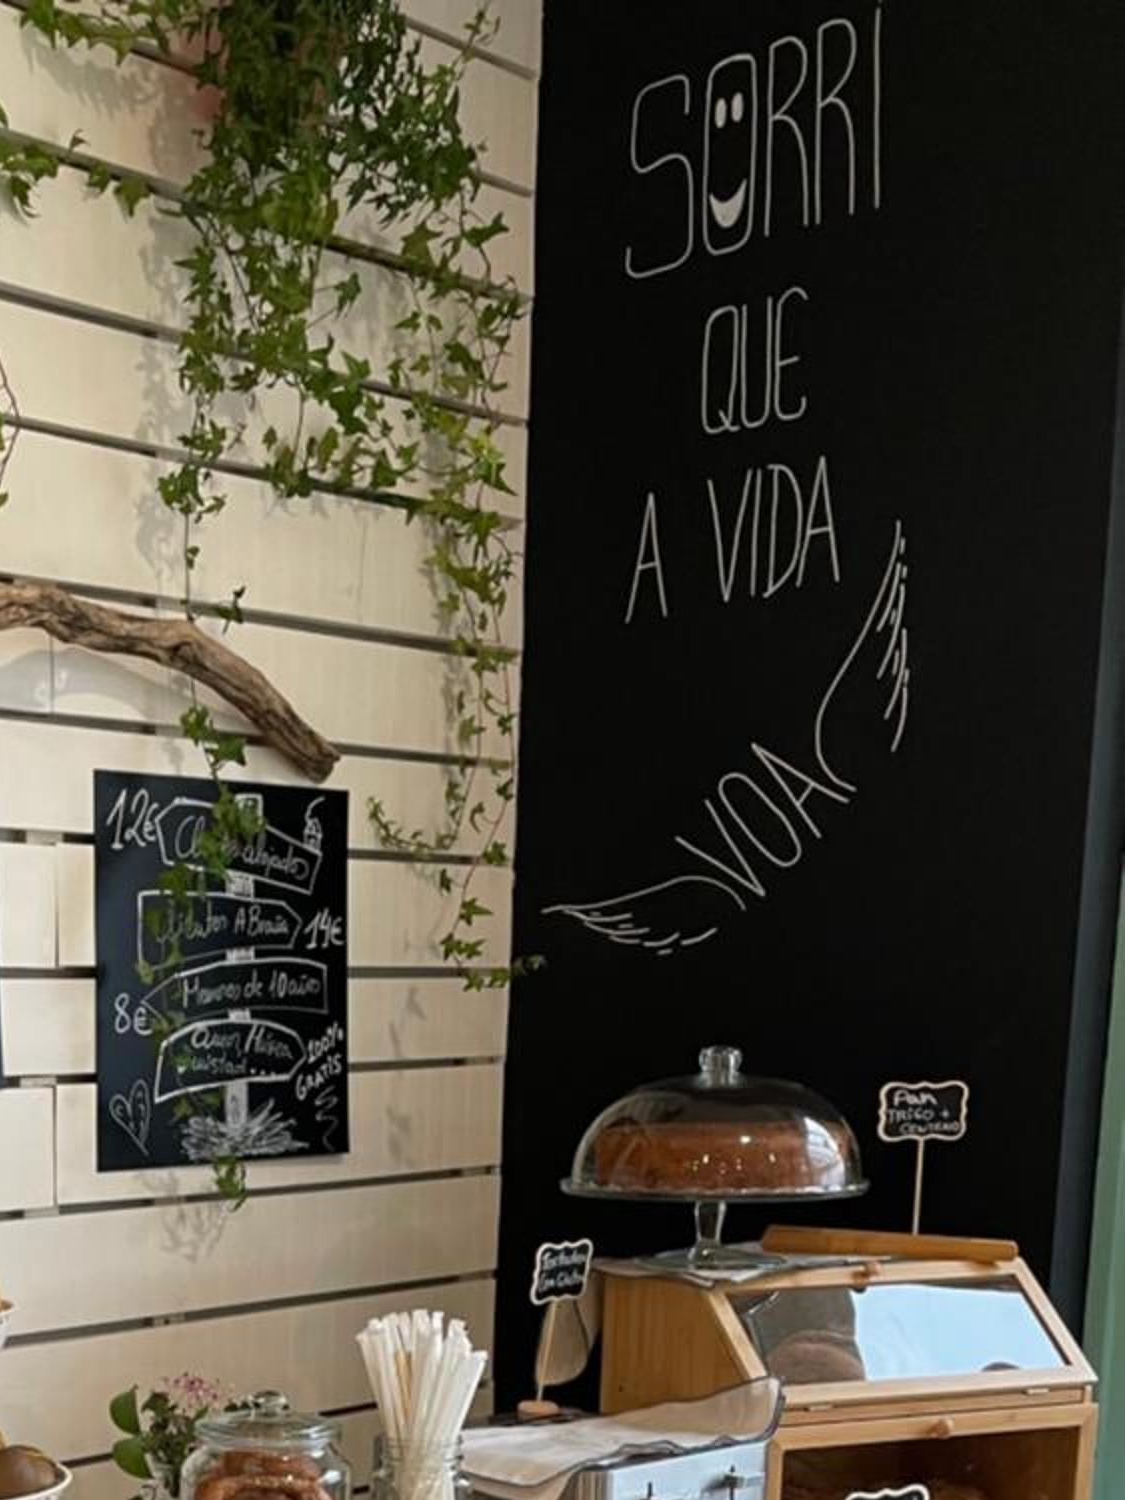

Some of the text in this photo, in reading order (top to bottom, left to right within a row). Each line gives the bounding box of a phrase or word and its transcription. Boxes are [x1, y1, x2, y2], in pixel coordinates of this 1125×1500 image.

[625, 9, 881, 279] SORRI
[701, 287, 809, 434] QUE
[625, 455, 840, 624] A VIDA
[676, 741, 852, 896] VOA
[304, 908, 346, 949] 14€
[114, 993, 153, 1035] 8€
